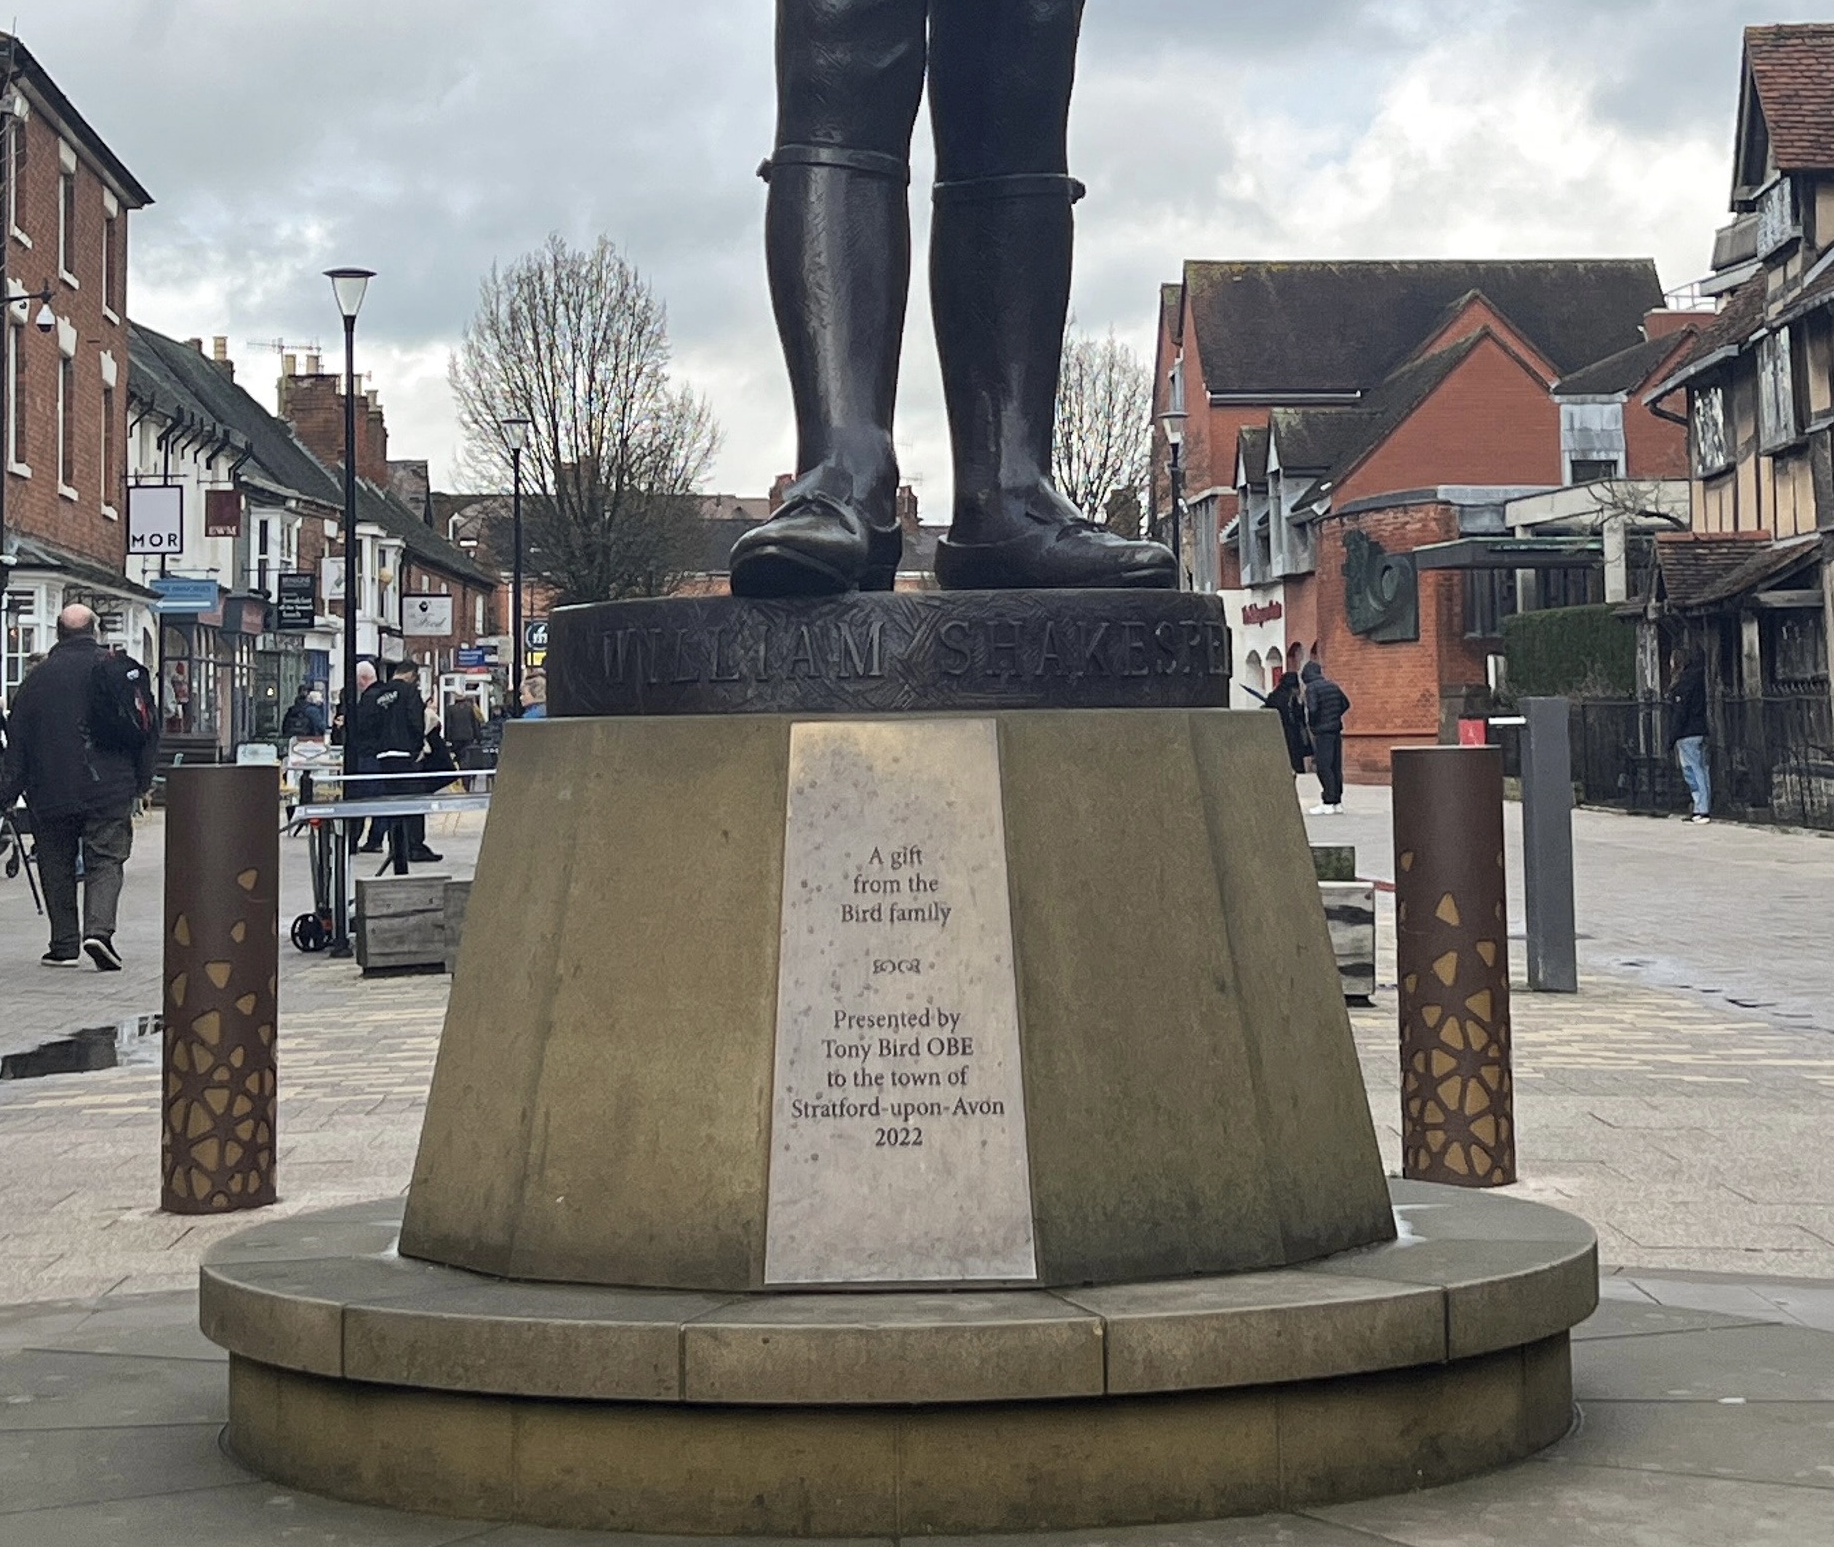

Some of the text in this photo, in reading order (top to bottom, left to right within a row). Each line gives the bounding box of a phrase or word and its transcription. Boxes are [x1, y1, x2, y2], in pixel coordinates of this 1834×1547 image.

[132, 533, 178, 548] MOR
[209, 525, 237, 536] EWM
[603, 620, 1231, 685] WILLIAM SHAKESPE
[868, 844, 923, 871] A gift
[853, 872, 939, 894] from the
[841, 901, 952, 928] Bird family
[834, 1007, 961, 1034] Presented by
[821, 1036, 974, 1064] Tony Bird OBE
[827, 1065, 969, 1087] to the town of
[791, 1096, 1005, 1123] Stratford-upon-Avon
[875, 1127, 923, 1147] 2022
